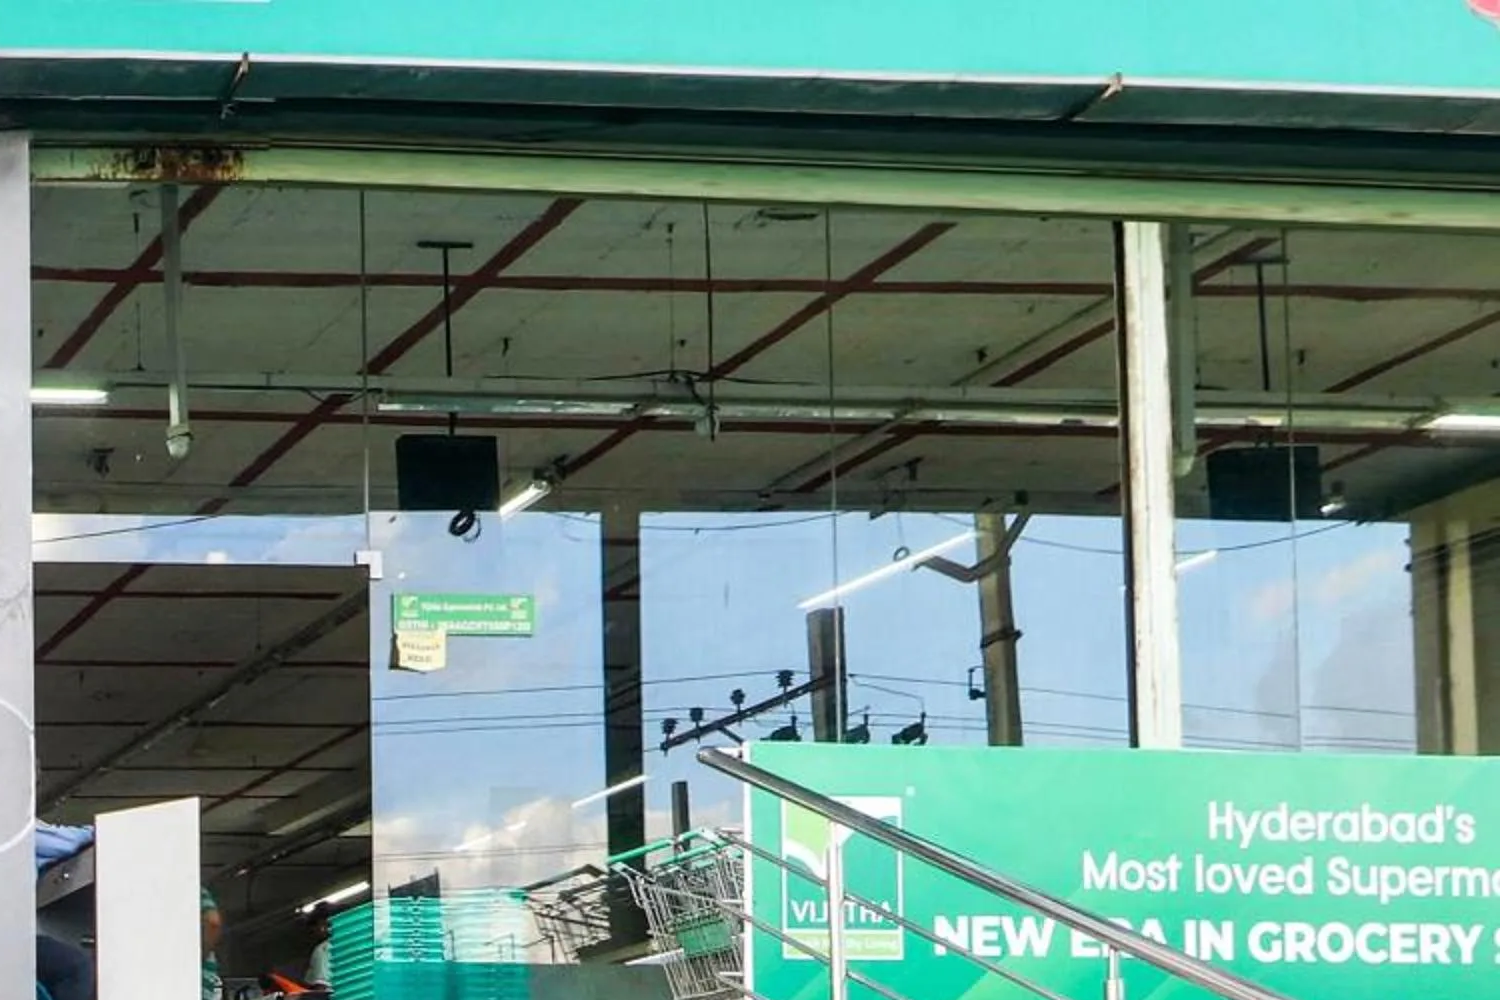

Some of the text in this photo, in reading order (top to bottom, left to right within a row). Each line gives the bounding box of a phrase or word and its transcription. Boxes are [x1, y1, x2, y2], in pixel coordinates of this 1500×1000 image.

[1208, 801, 1475, 850] Hyderabad's
[1082, 851, 1179, 890] Most
[1196, 854, 1313, 893] loved
[791, 900, 894, 923] VIJTHA
[934, 915, 1057, 957] NEW
[1184, 920, 1234, 961] IN
[1249, 921, 1485, 963] GROCERY
